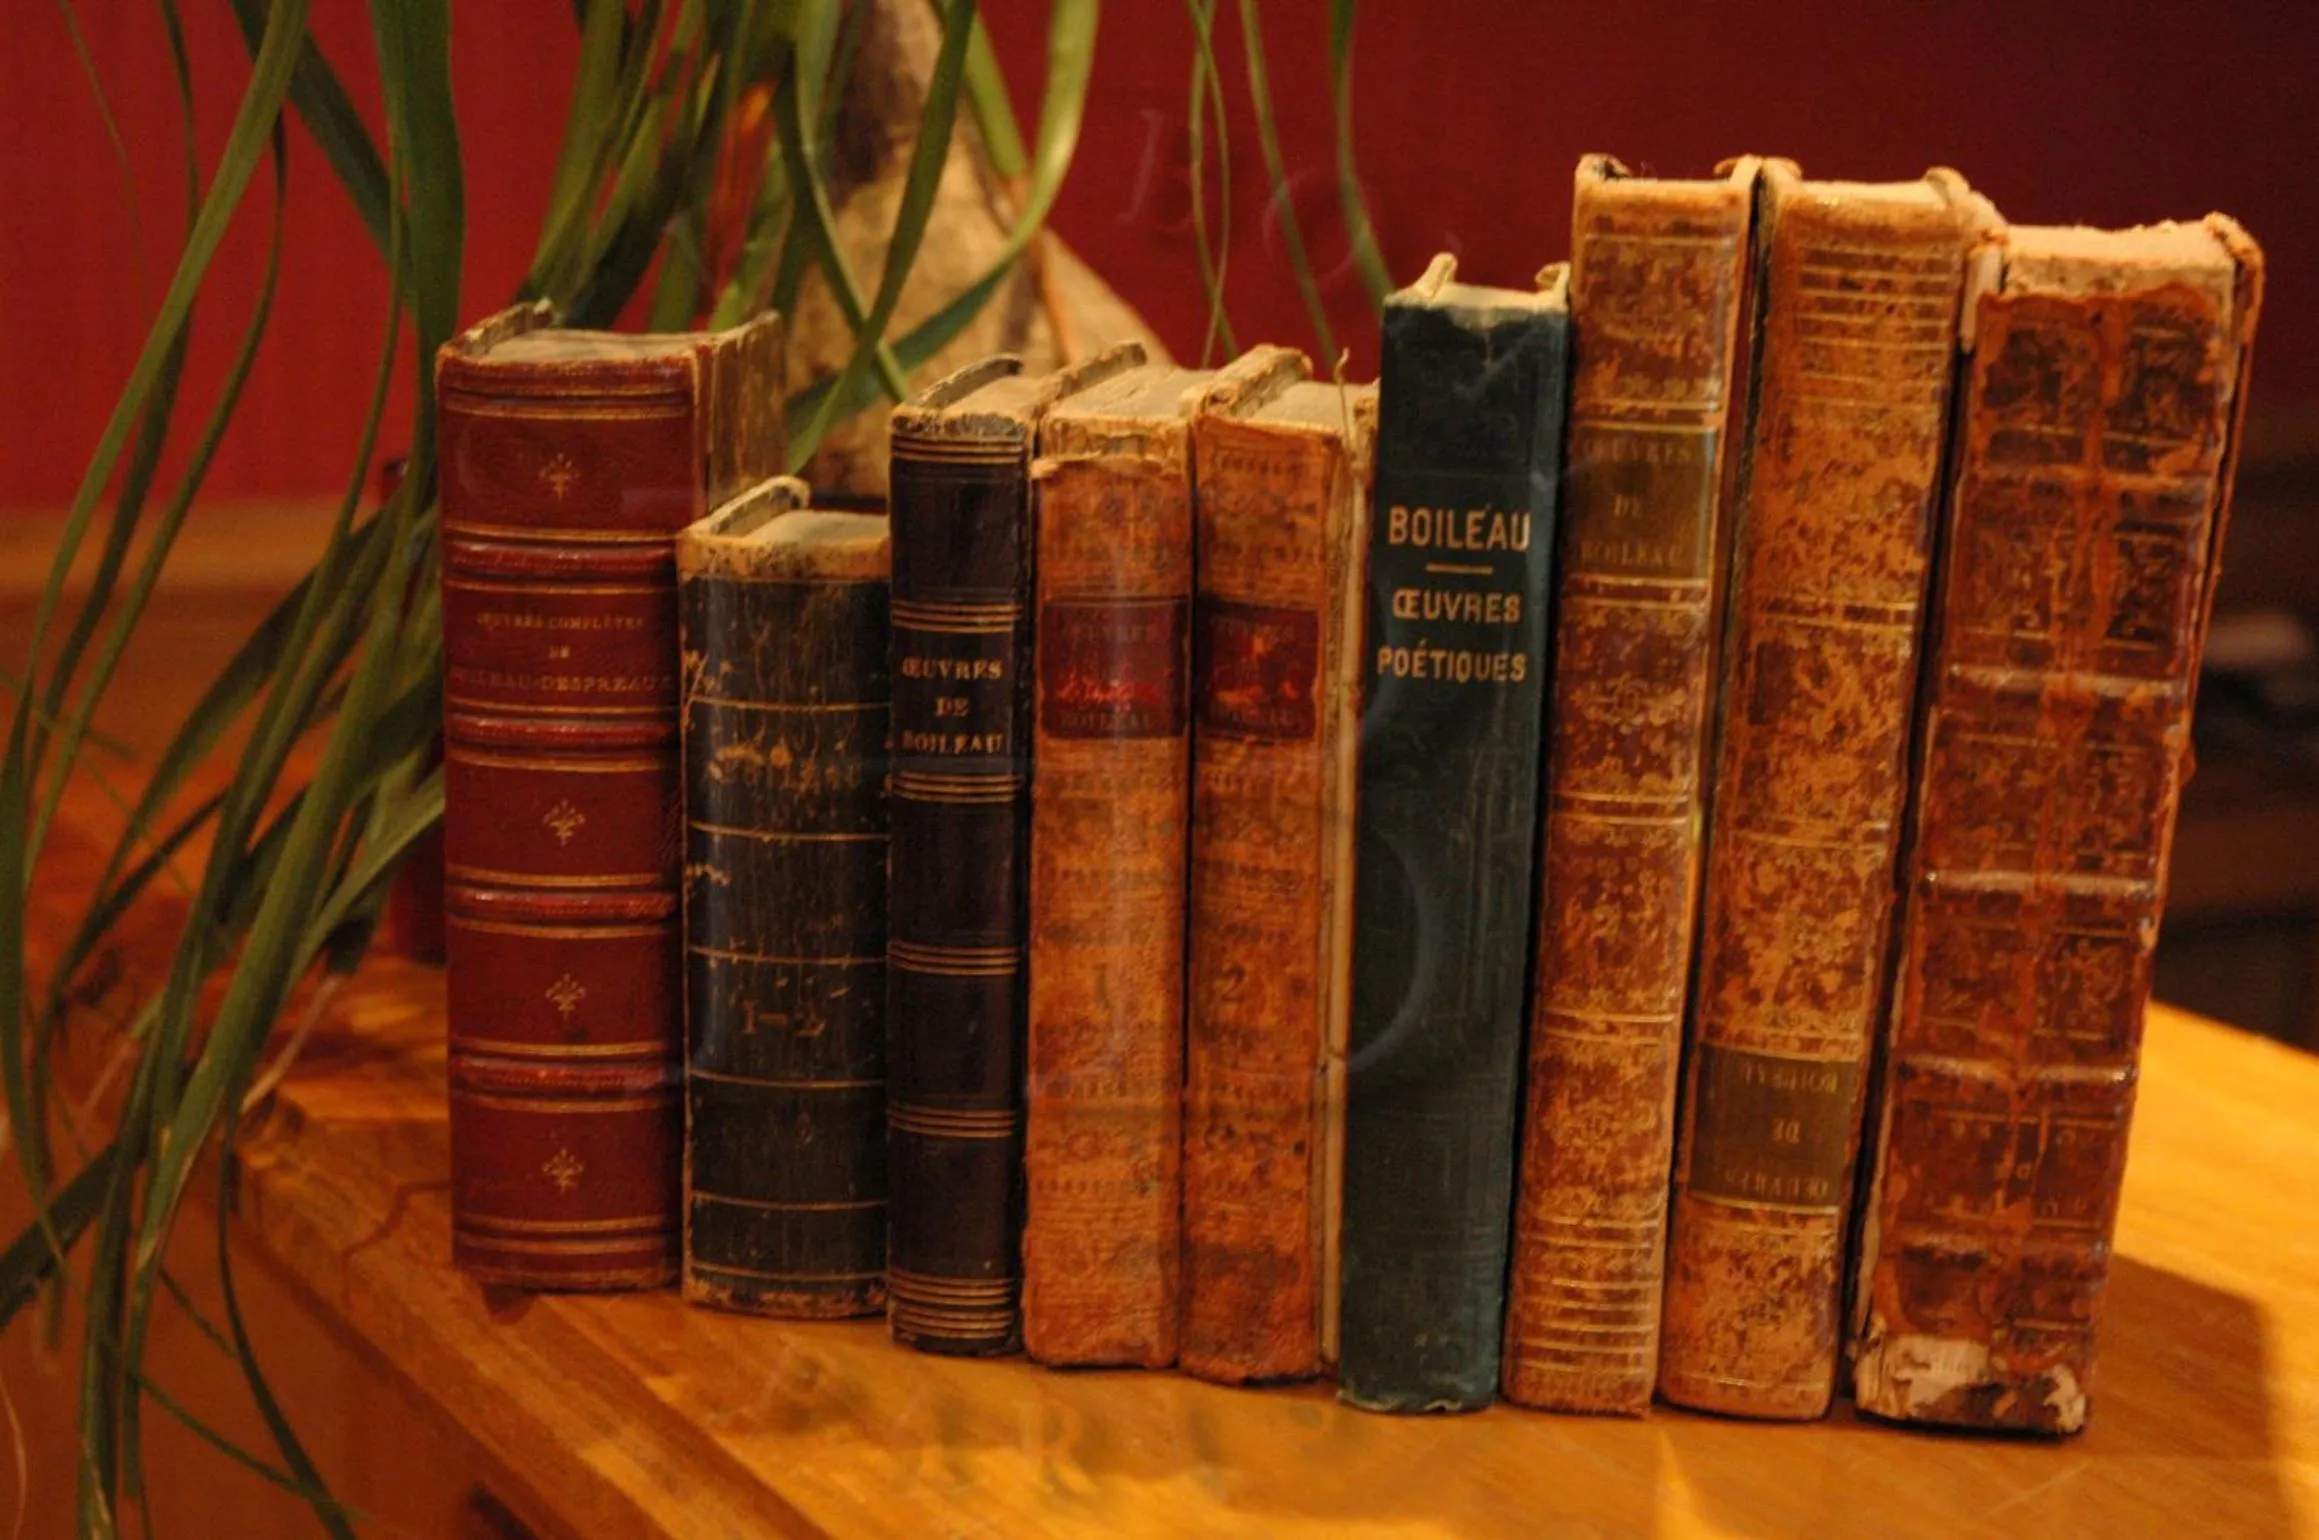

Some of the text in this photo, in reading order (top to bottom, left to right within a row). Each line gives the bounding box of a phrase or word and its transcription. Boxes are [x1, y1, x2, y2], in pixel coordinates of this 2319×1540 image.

[1392, 587, 1523, 624] ŒUVRES
[901, 655, 1004, 682] ŒUVRES
[1375, 637, 1530, 684] POÉTIQUES
[934, 694, 970, 719] DE
[901, 728, 1005, 756] BOILEAU
